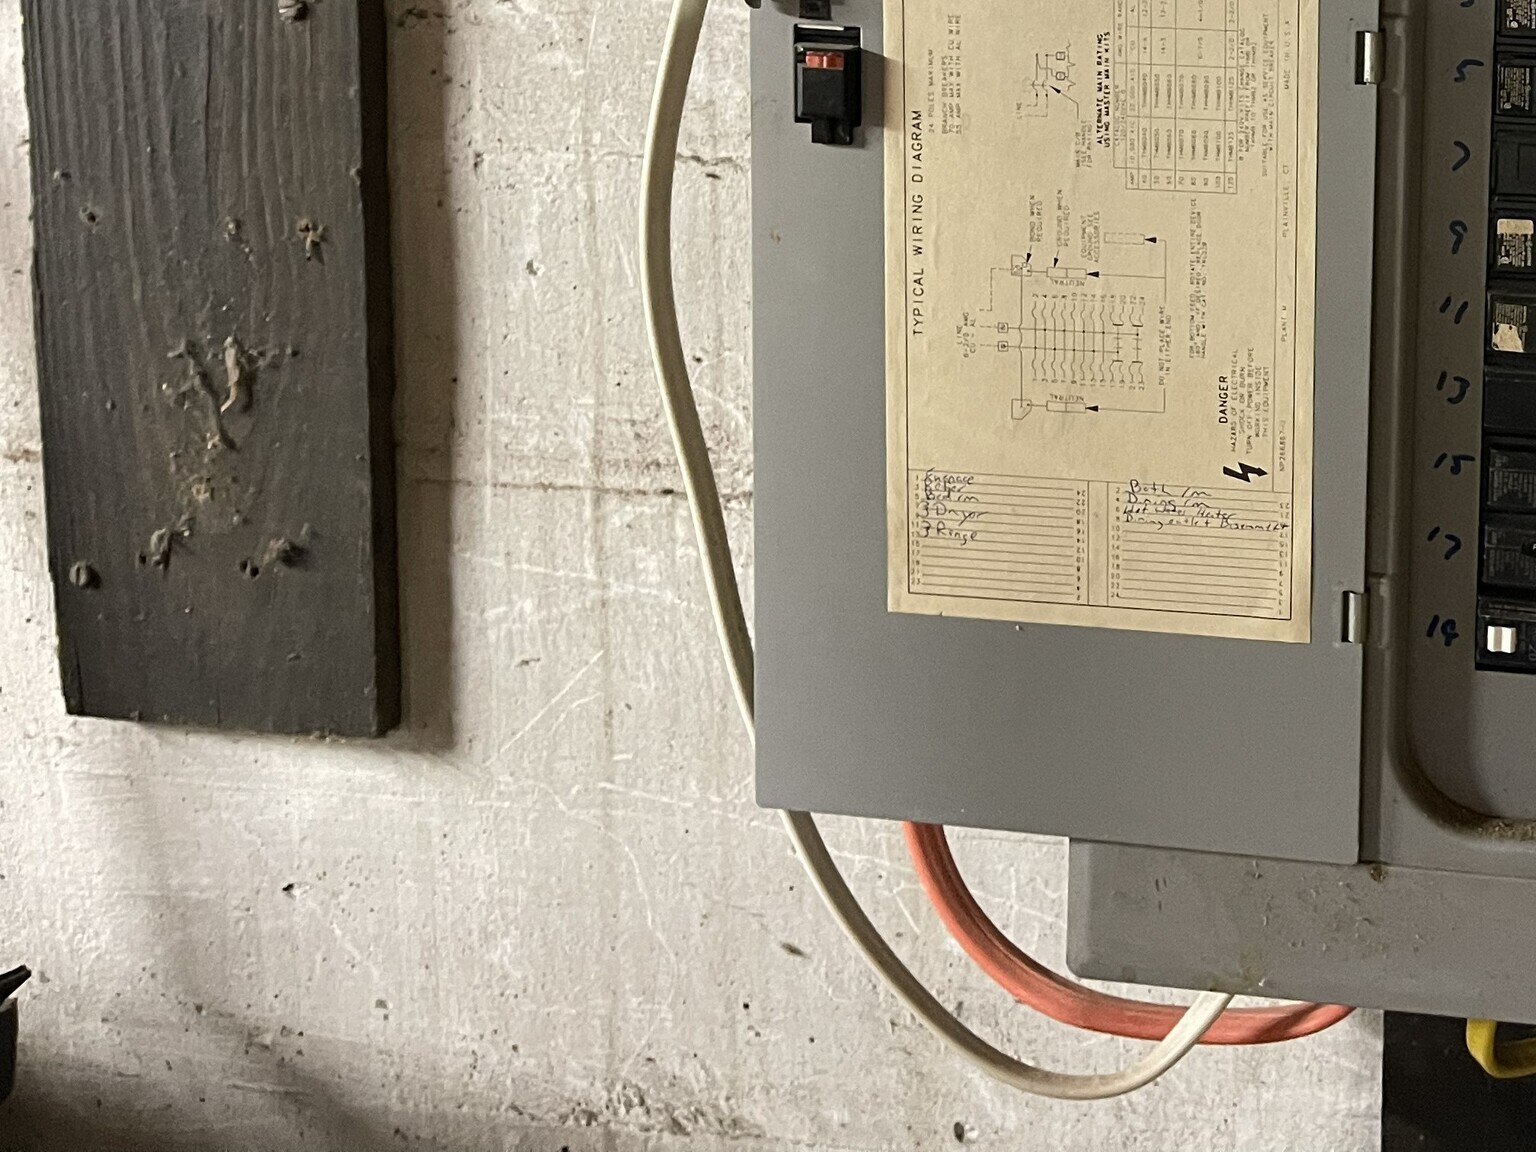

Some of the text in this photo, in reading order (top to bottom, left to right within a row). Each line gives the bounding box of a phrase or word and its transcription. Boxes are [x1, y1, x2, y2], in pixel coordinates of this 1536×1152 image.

[1454, 61, 1483, 81] 5
[1103, 118, 1111, 148] USING
[1453, 141, 1470, 171] 7
[911, 110, 924, 336] TYPICAL WIRING DIAGRAM
[1449, 221, 1468, 253] 9
[1440, 296, 1469, 323] 11
[1218, 375, 1228, 424] DANGER
[1437, 371, 1470, 404] 13
[1434, 453, 1475, 474] 15
[1428, 528, 1462, 560] 17
